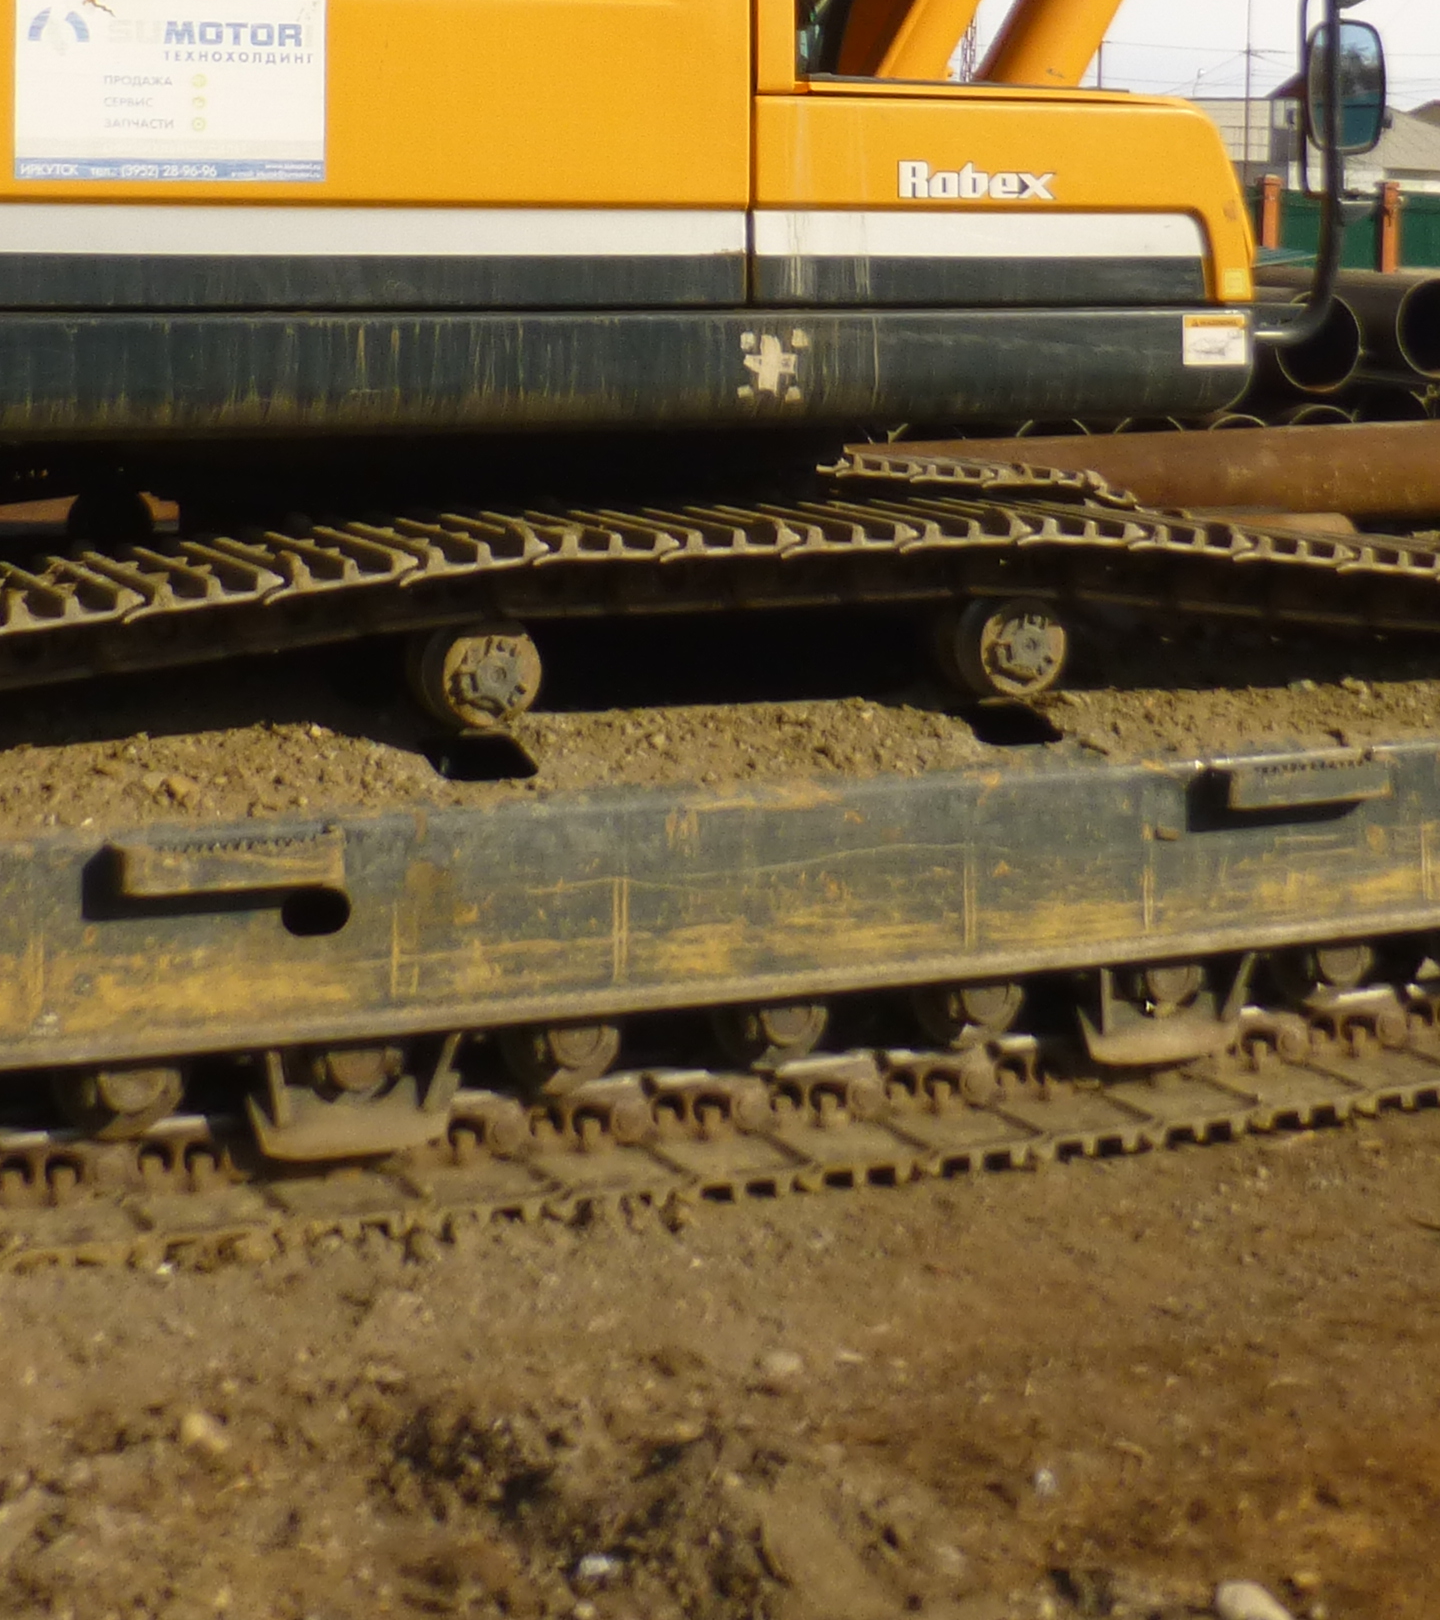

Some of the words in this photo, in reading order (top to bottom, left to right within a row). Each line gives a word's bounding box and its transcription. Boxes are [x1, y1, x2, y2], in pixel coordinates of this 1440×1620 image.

[163, 50, 314, 66] ТЕХНОХОЛДИНГ
[103, 74, 173, 87] ПРОДАЖА
[103, 97, 154, 108] СЕРВИС
[103, 118, 175, 130] ЗАПЧАСТИ
[20, 163, 79, 176] ИРКУТСК
[121, 164, 159, 178] (3952)
[162, 165, 218, 178] 28-96-96
[897, 158, 1055, 201] Robex
